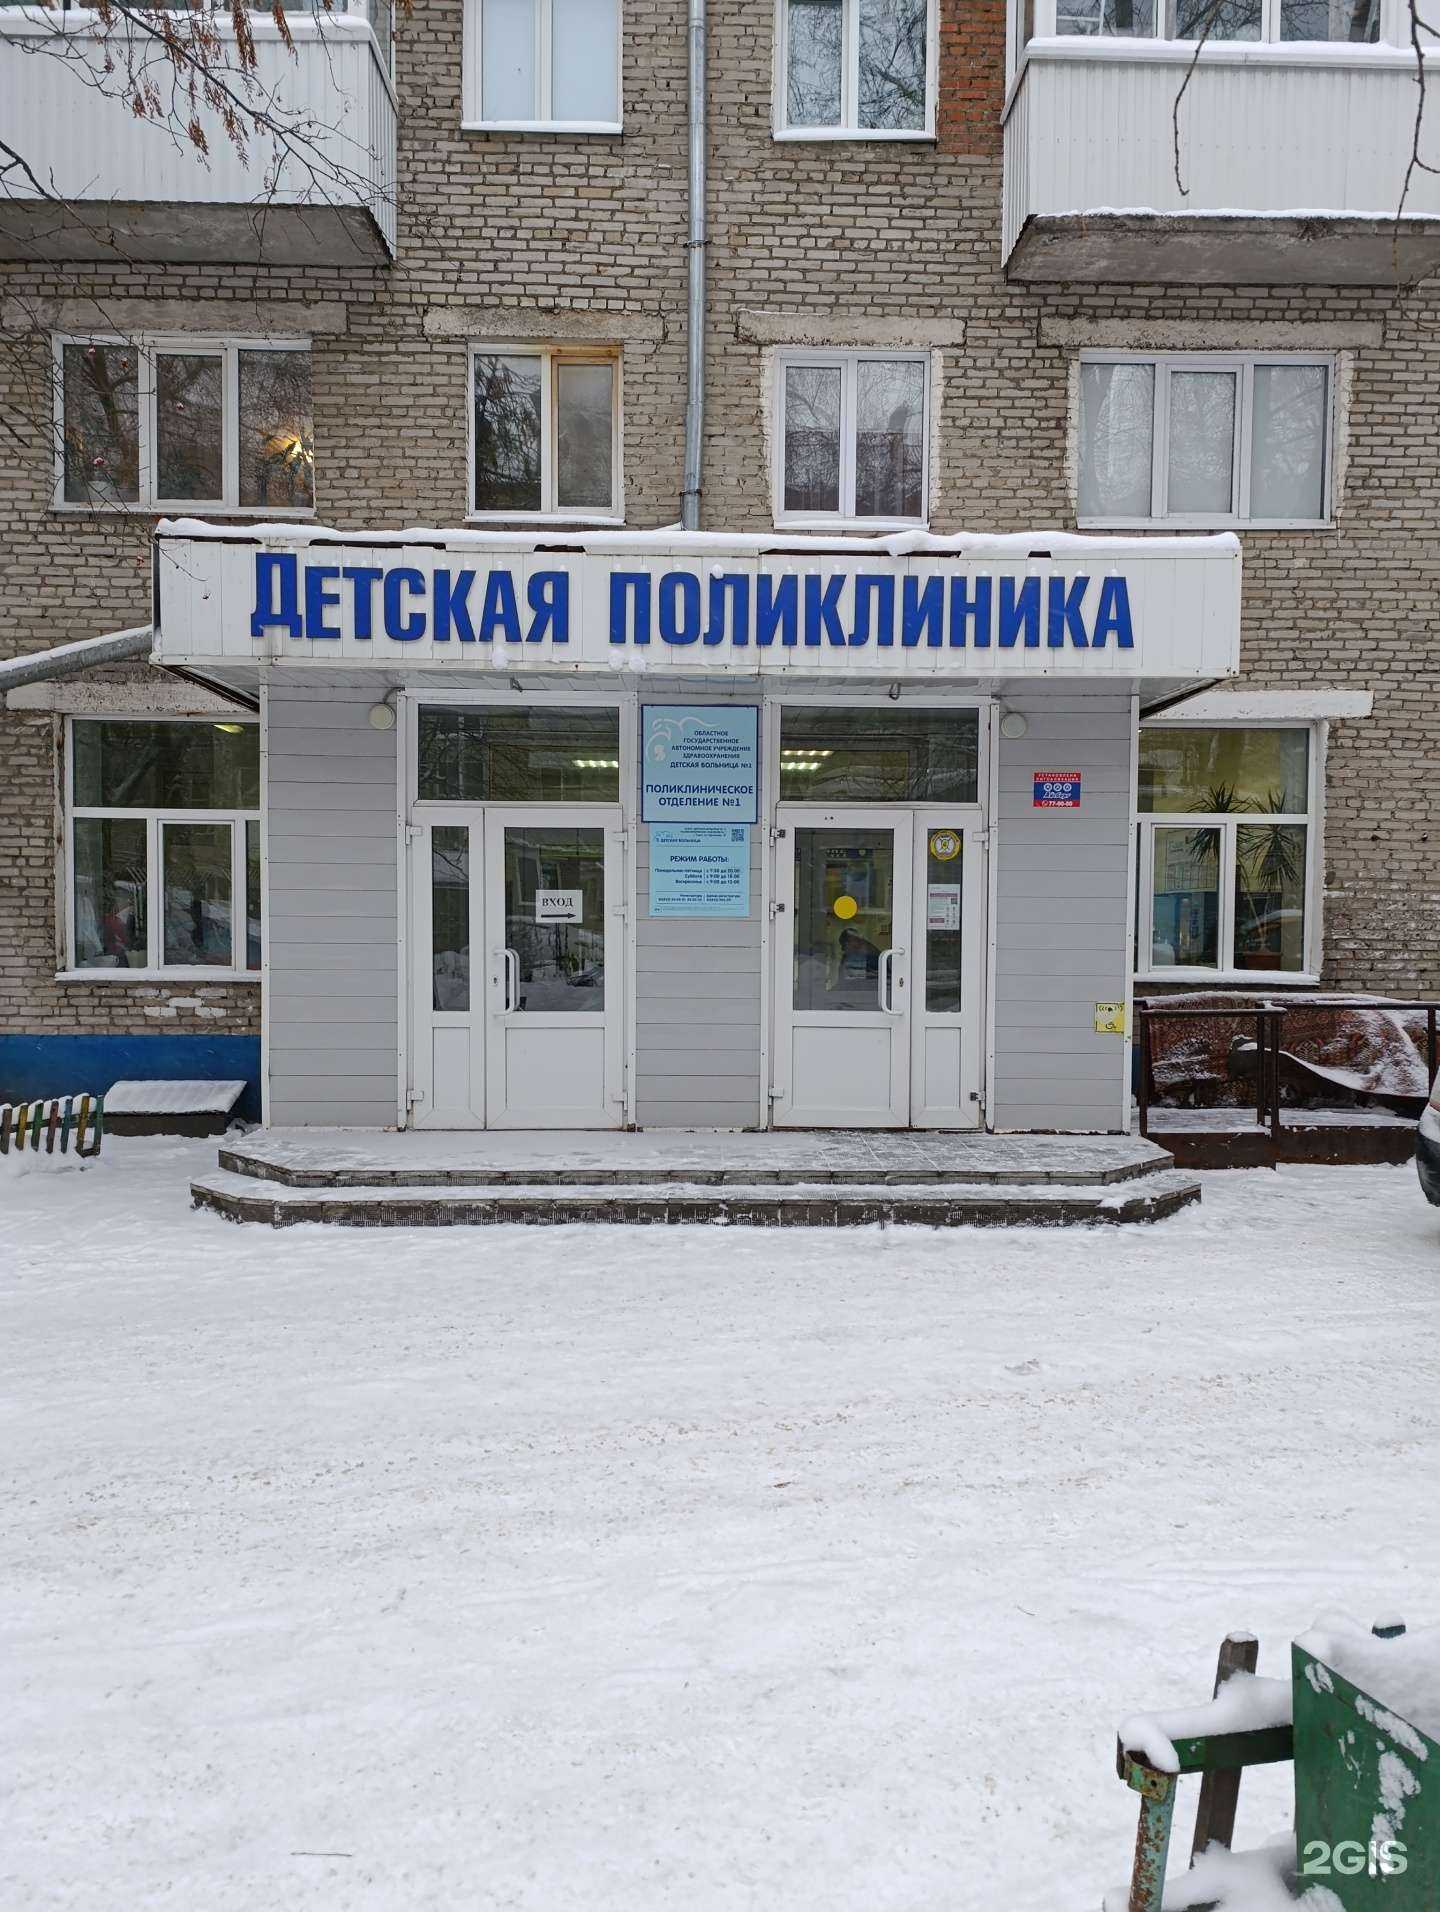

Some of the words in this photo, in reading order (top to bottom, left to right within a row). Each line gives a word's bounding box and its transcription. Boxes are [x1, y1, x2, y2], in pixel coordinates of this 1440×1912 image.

[250, 552, 570, 643] ДЕТСКАЯ
[609, 571, 1134, 648] ПОЛИКЛИНИКА
[646, 784, 753, 794] ПОЛИКЛИНИЧЕСКОЕ
[658, 797, 719, 807] ОТДЕЛЕНИЕ
[722, 798, 741, 807] №1
[542, 897, 573, 907] ВХОД
